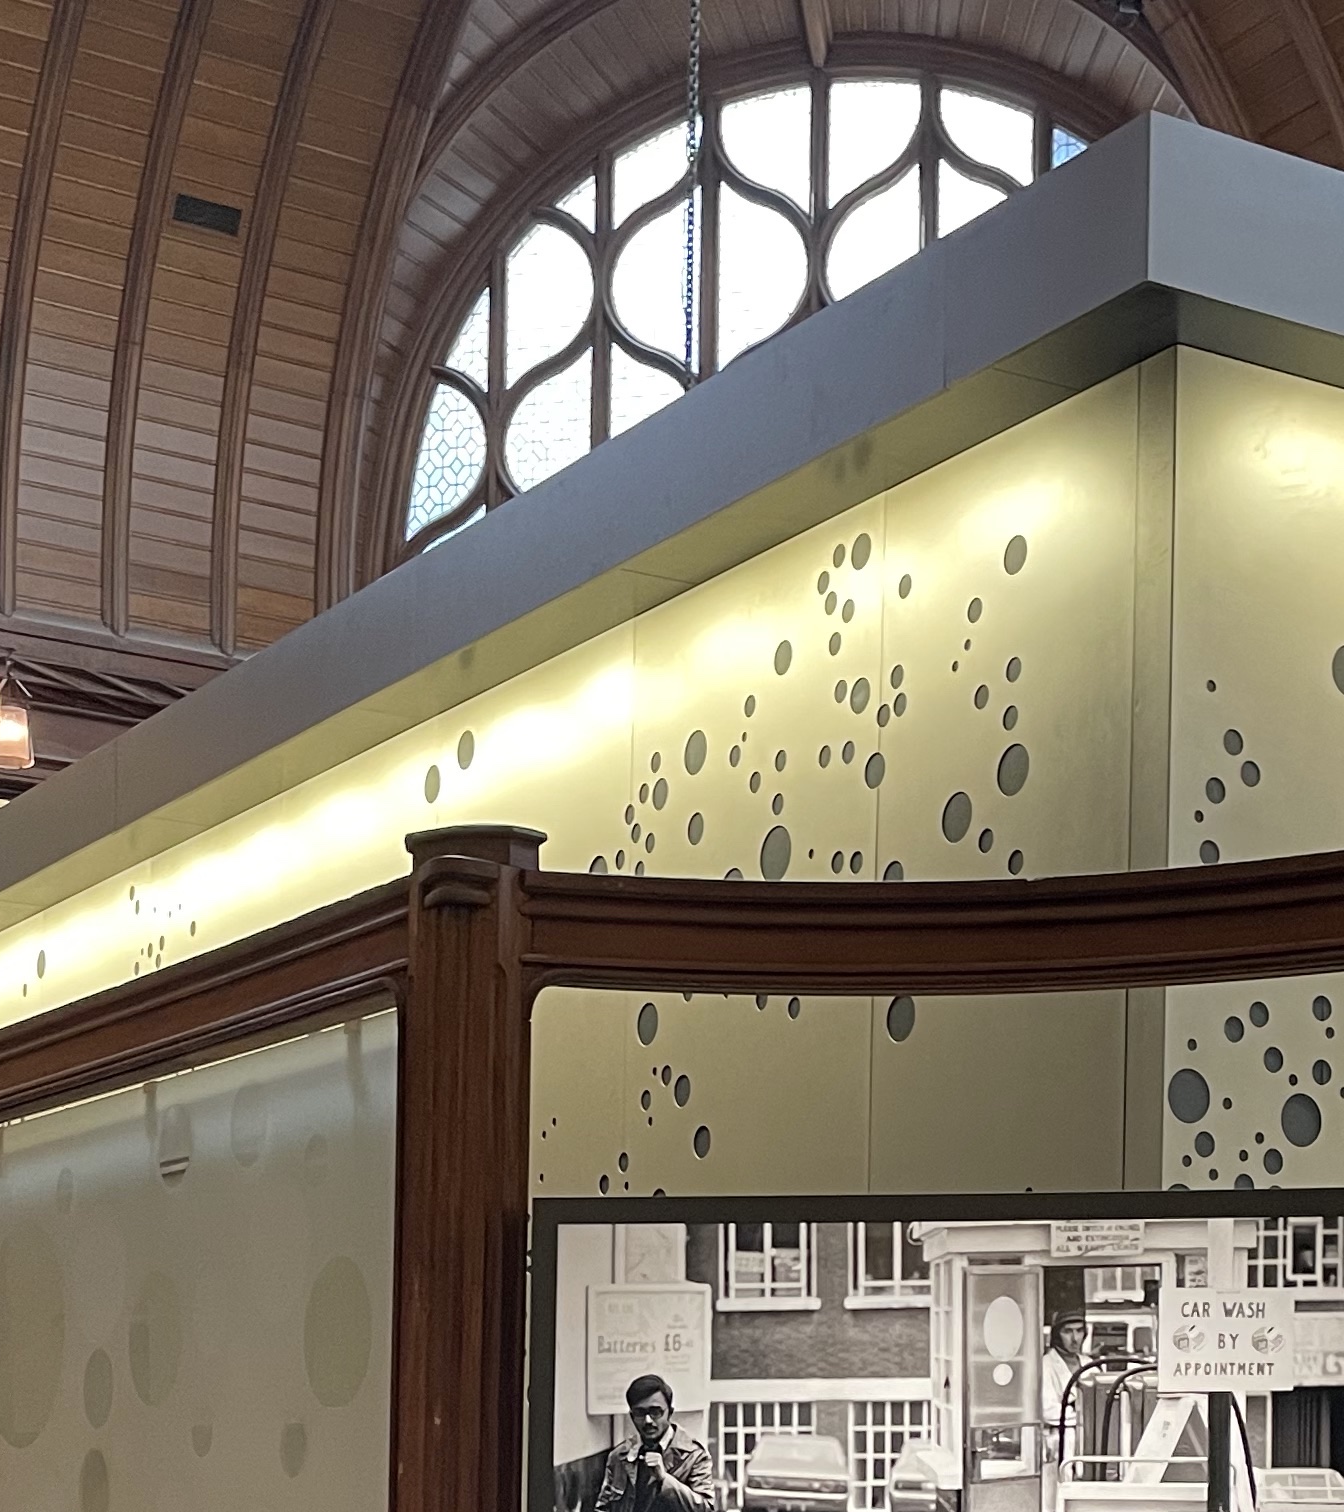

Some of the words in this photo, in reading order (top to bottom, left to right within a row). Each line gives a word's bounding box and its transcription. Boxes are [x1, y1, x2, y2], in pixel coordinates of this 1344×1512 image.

[1181, 1301, 1210, 1318] CAR
[1223, 1301, 1266, 1318] WASH
[1217, 1333, 1239, 1349] BY
[1173, 1362, 1275, 1377] APPOINTMENT
